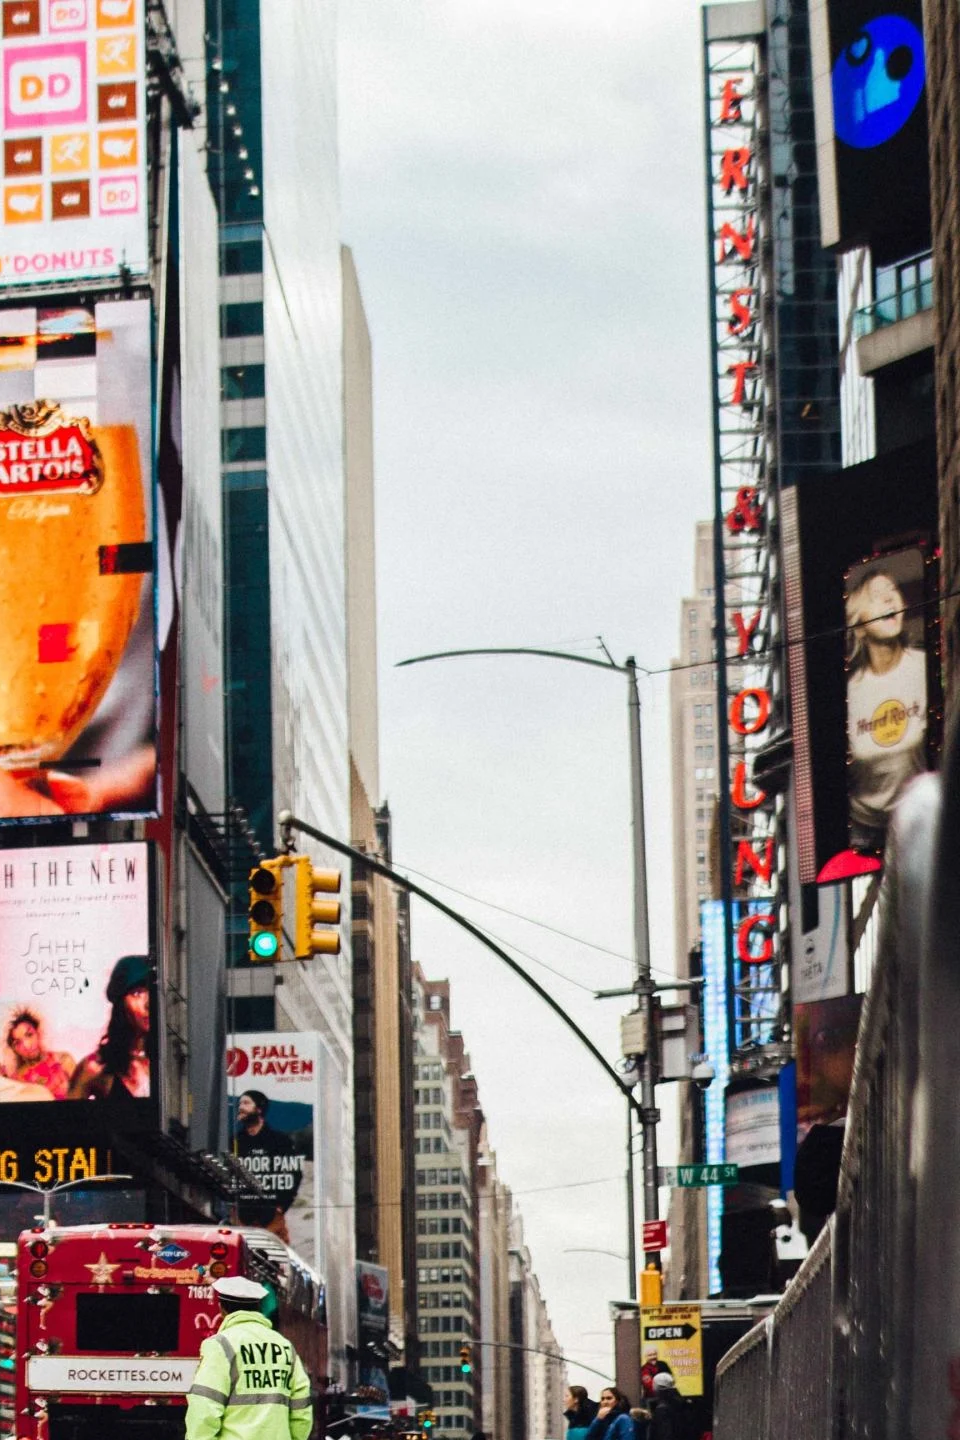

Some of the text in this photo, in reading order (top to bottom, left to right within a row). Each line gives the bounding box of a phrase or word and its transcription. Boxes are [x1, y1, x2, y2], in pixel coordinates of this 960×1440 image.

[20, 73, 71, 103] DD
[719, 78, 756, 406] ERNST
[13, 248, 115, 274] DONUTS
[32, 860, 73, 888] THE
[90, 857, 136, 885] NEW
[25, 958, 86, 975] OWER
[273, 1154, 306, 1172] PANT
[681, 1168, 694, 1185] W
[700, 1167, 719, 1183] 44
[648, 1327, 683, 1340] OPEN
[67, 1369, 183, 1382] ROCKETTES.COM
